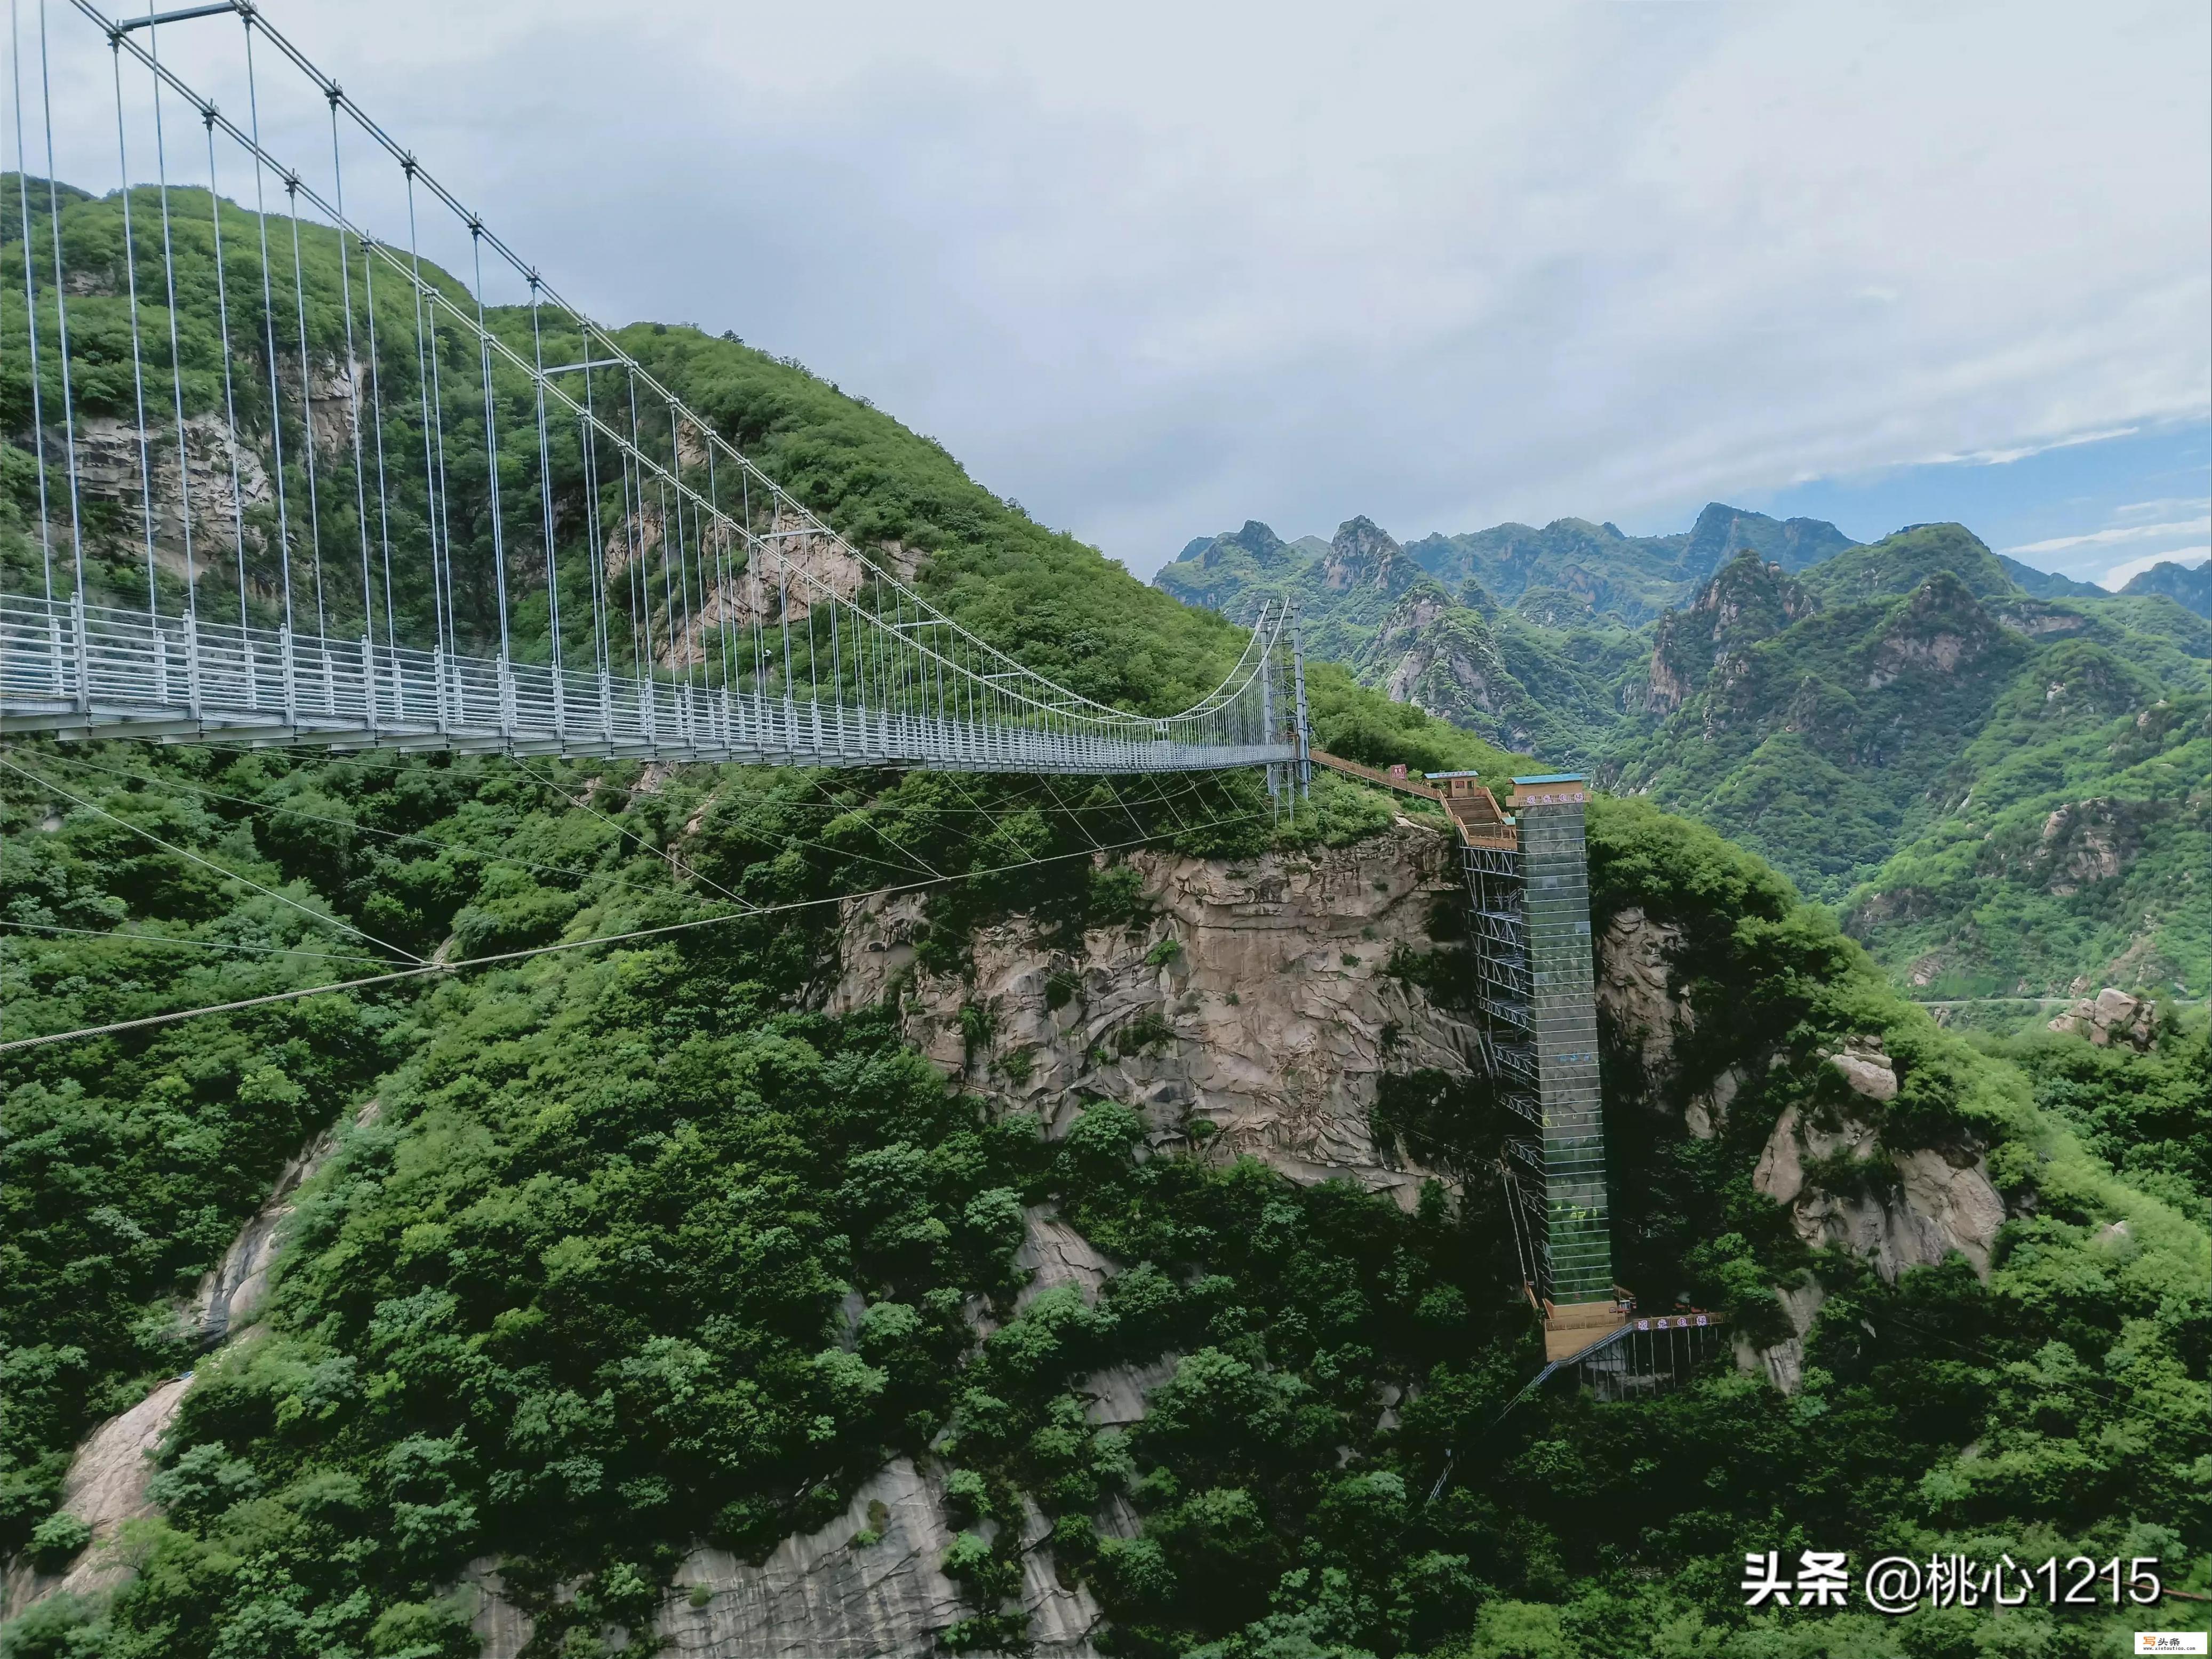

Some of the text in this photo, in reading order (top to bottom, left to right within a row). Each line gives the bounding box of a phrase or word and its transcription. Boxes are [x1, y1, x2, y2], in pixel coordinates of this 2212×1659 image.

[1527, 793, 1584, 804] 观光电梯
[1638, 1315, 1707, 1330] 观光电梯
